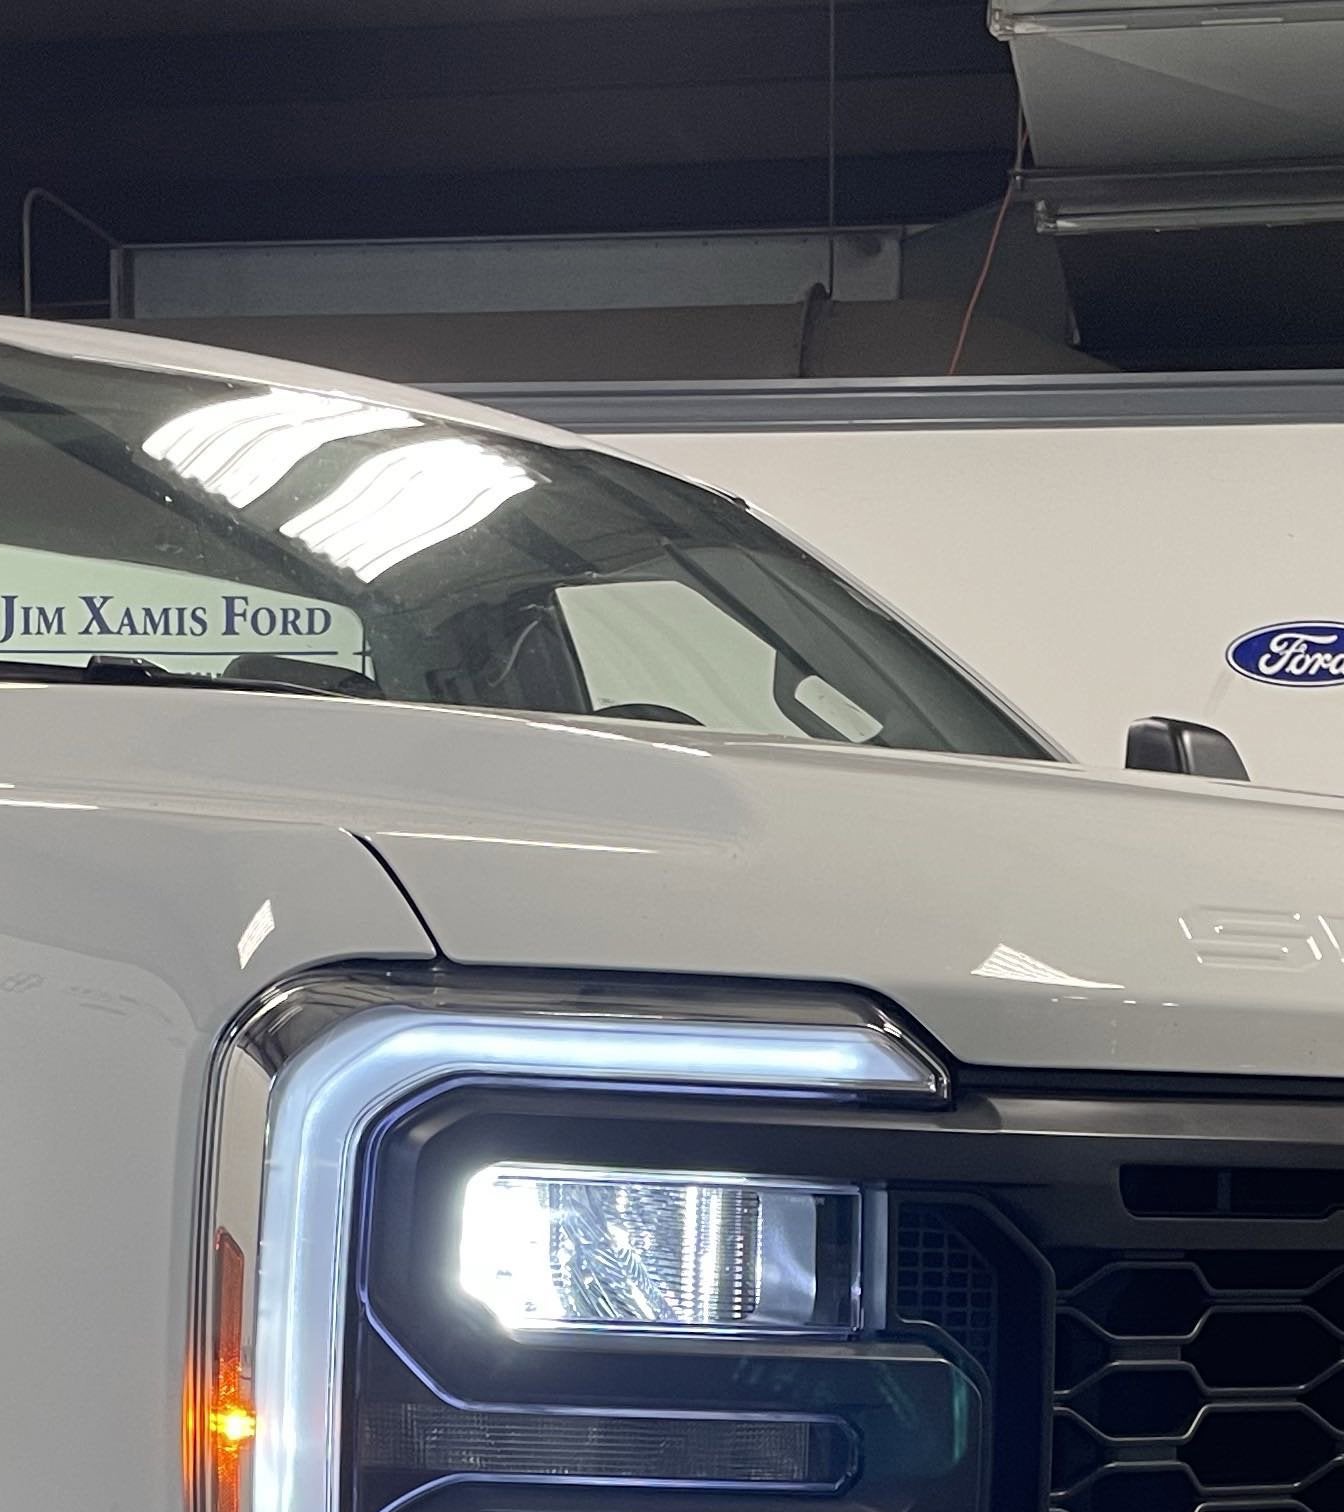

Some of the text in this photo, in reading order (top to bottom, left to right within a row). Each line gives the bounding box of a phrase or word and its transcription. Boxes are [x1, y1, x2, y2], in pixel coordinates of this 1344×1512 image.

[0, 595, 333, 644] JIM XAMIS FORD
